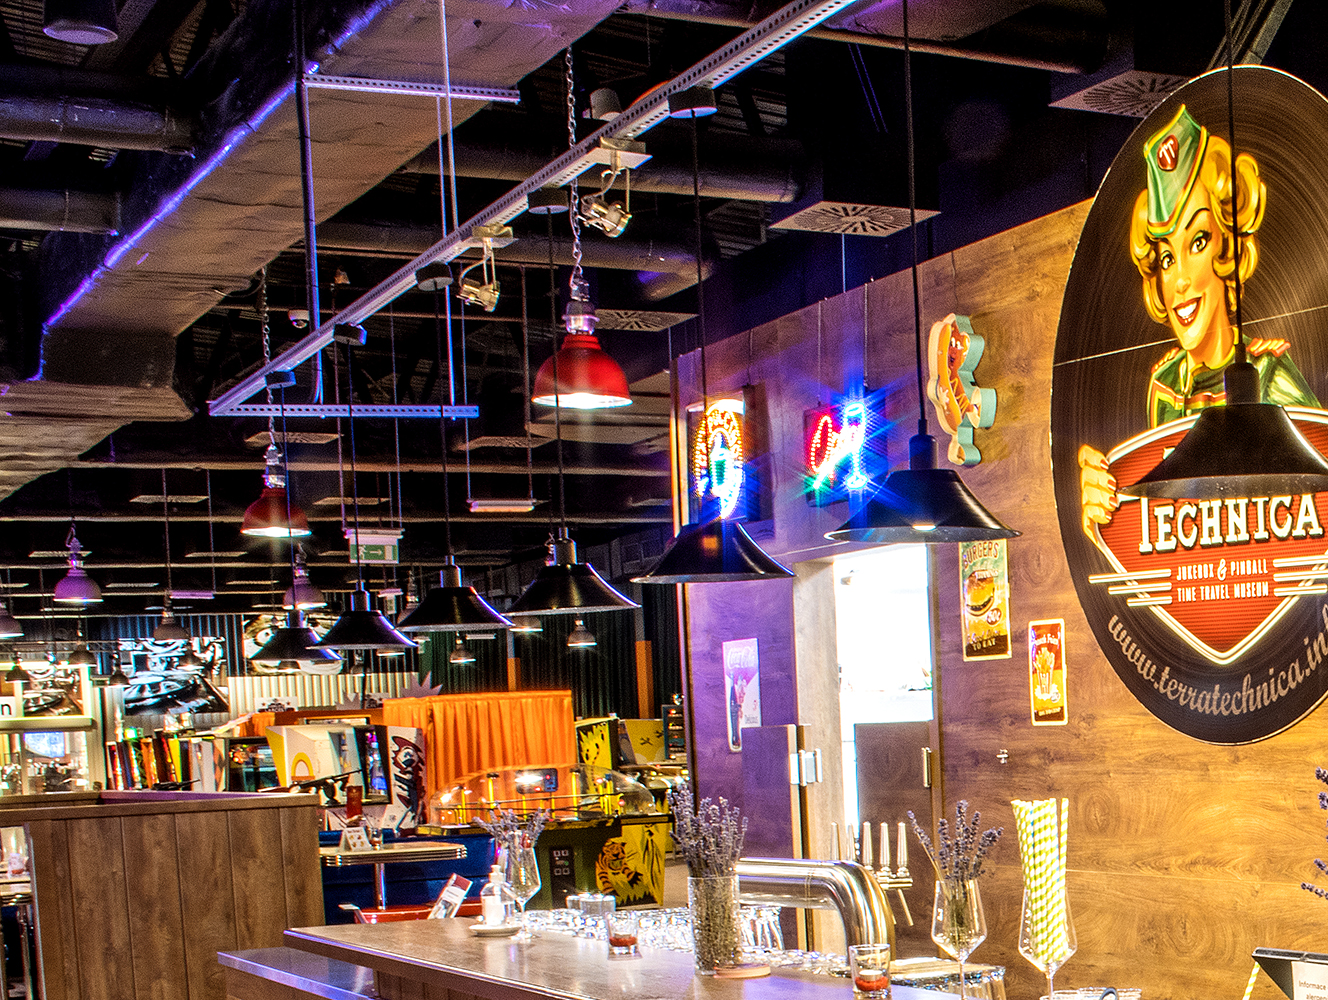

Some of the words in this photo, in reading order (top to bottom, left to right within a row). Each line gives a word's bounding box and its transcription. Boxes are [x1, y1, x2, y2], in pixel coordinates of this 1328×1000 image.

[1139, 494, 1325, 554] TECHNICA
[963, 541, 999, 572] BURGERS
[1176, 564, 1214, 581] JUKEBOX
[1216, 559, 1228, 581] &
[1230, 559, 1269, 576] PINBALL
[1176, 587, 1197, 603] TIME
[1200, 583, 1231, 601] TRAVEL
[1233, 581, 1270, 599] MUSEUM
[1298, 980, 1327, 991] Informace
